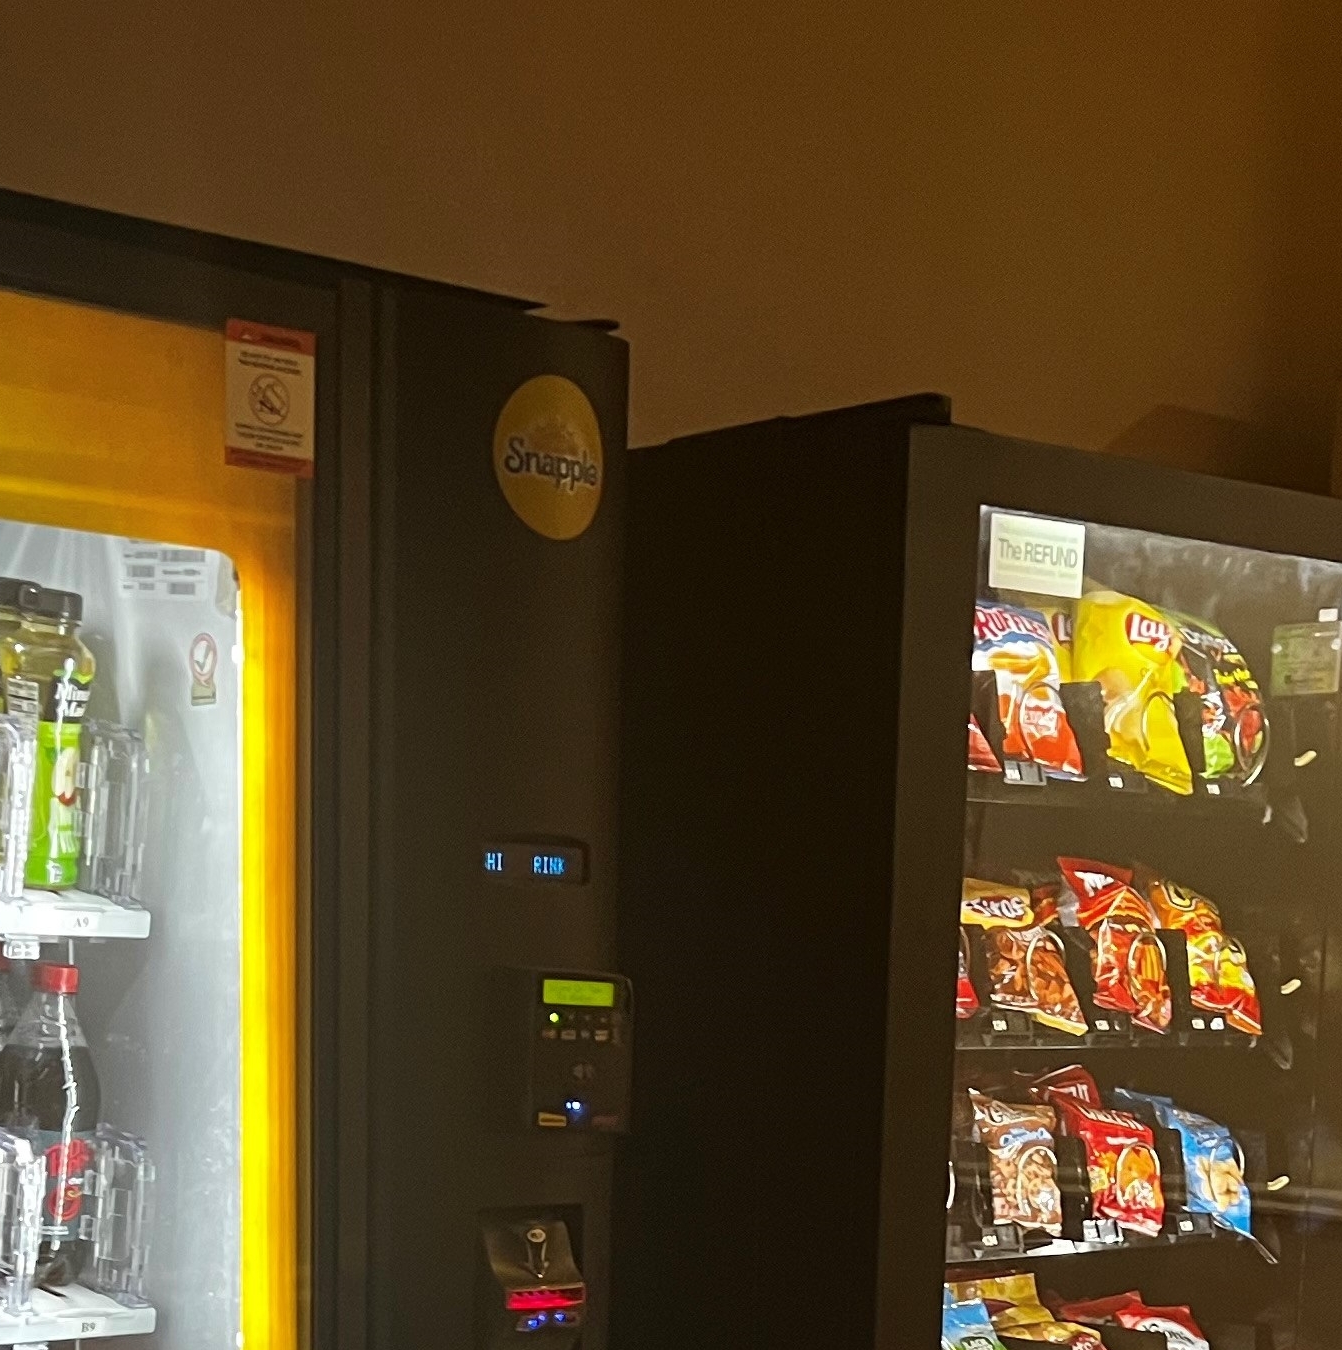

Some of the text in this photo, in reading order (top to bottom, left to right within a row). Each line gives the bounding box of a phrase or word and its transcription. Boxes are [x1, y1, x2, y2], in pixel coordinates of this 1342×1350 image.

[504, 437, 597, 491] Snapple
[998, 538, 1078, 568] The REFUND
[485, 852, 503, 872] HI
[73, 916, 89, 929] A9
[81, 1322, 96, 1333] B9
